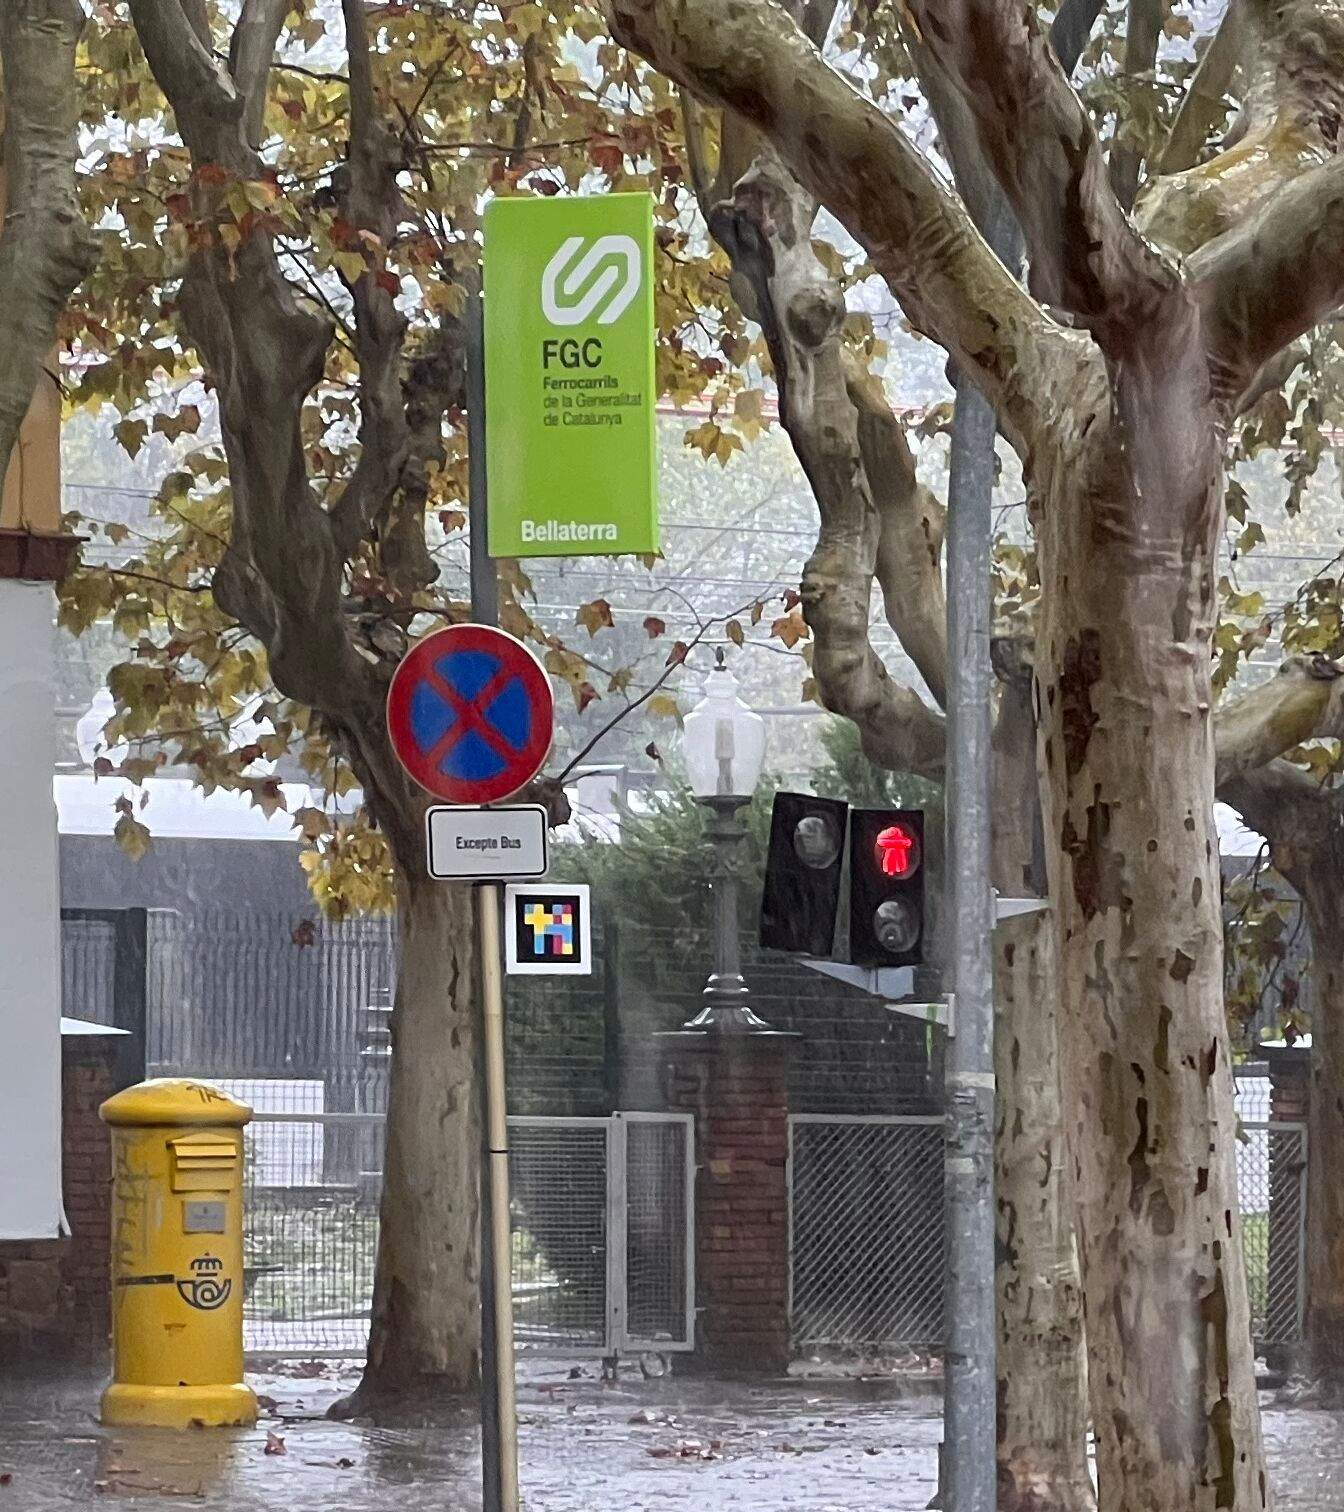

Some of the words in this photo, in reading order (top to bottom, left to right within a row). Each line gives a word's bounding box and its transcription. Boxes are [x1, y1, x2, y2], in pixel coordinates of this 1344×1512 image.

[543, 338, 602, 370] FGC
[543, 375, 618, 390] Ferrocarrils
[543, 396, 559, 409] de
[562, 395, 573, 408] la
[576, 393, 641, 408] Generalitat
[543, 413, 559, 427] de
[563, 411, 622, 428] Catalunya
[521, 520, 618, 541] Bellaterra
[456, 836, 498, 852] Excepte
[501, 836, 521, 849] Bus
